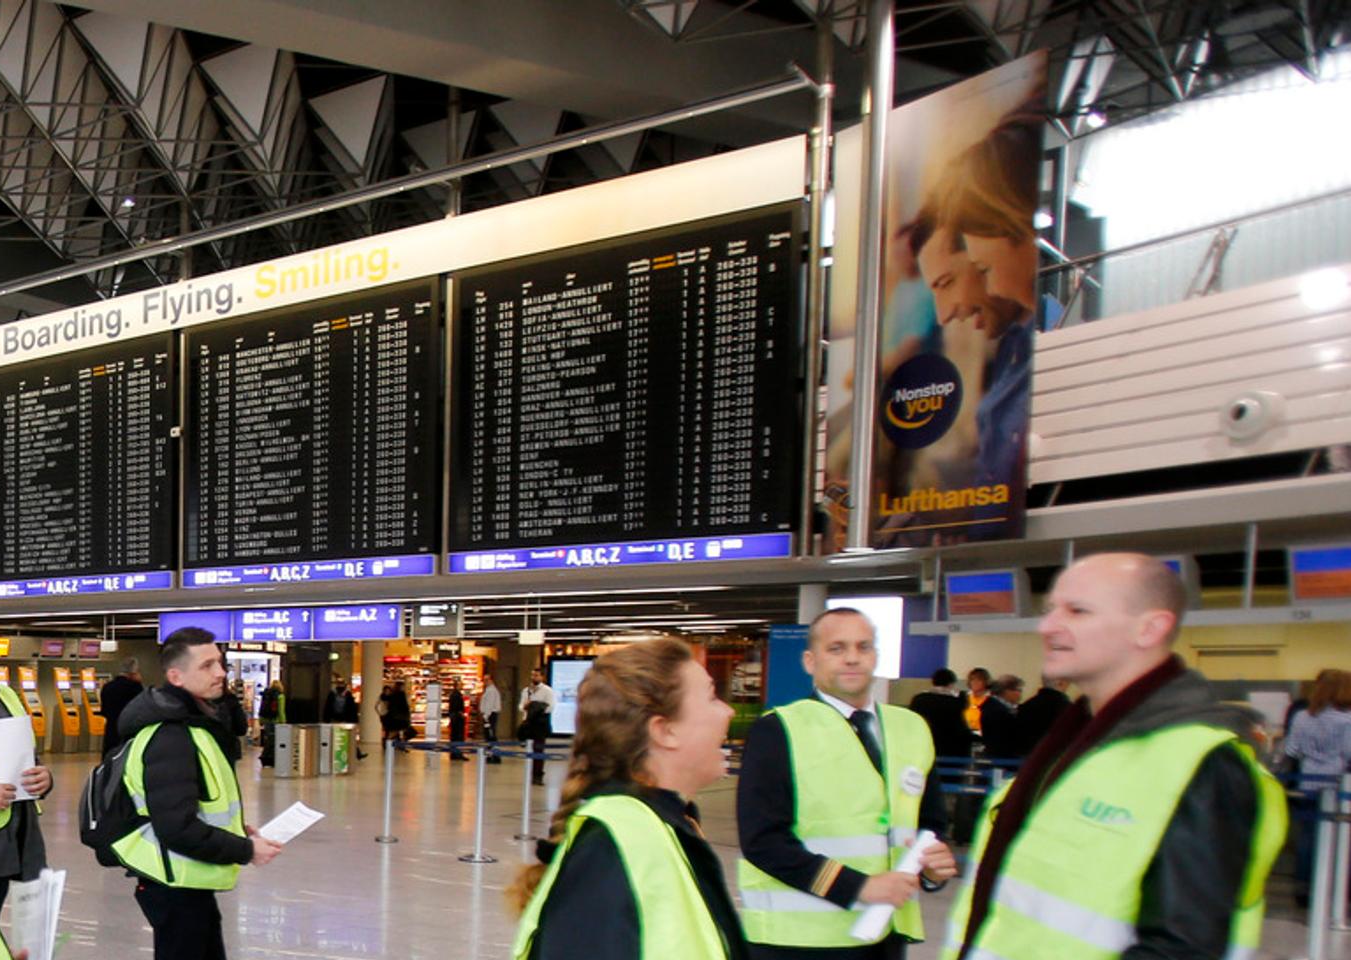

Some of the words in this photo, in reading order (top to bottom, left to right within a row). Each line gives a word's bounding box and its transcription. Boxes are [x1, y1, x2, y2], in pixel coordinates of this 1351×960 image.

[3, 308, 130, 355] Boarding.
[143, 281, 243, 325] Flying.
[255, 244, 401, 298] Smiling.
[896, 381, 955, 403] Nonstop
[906, 396, 942, 420] you
[879, 483, 1009, 516] Lufthansa
